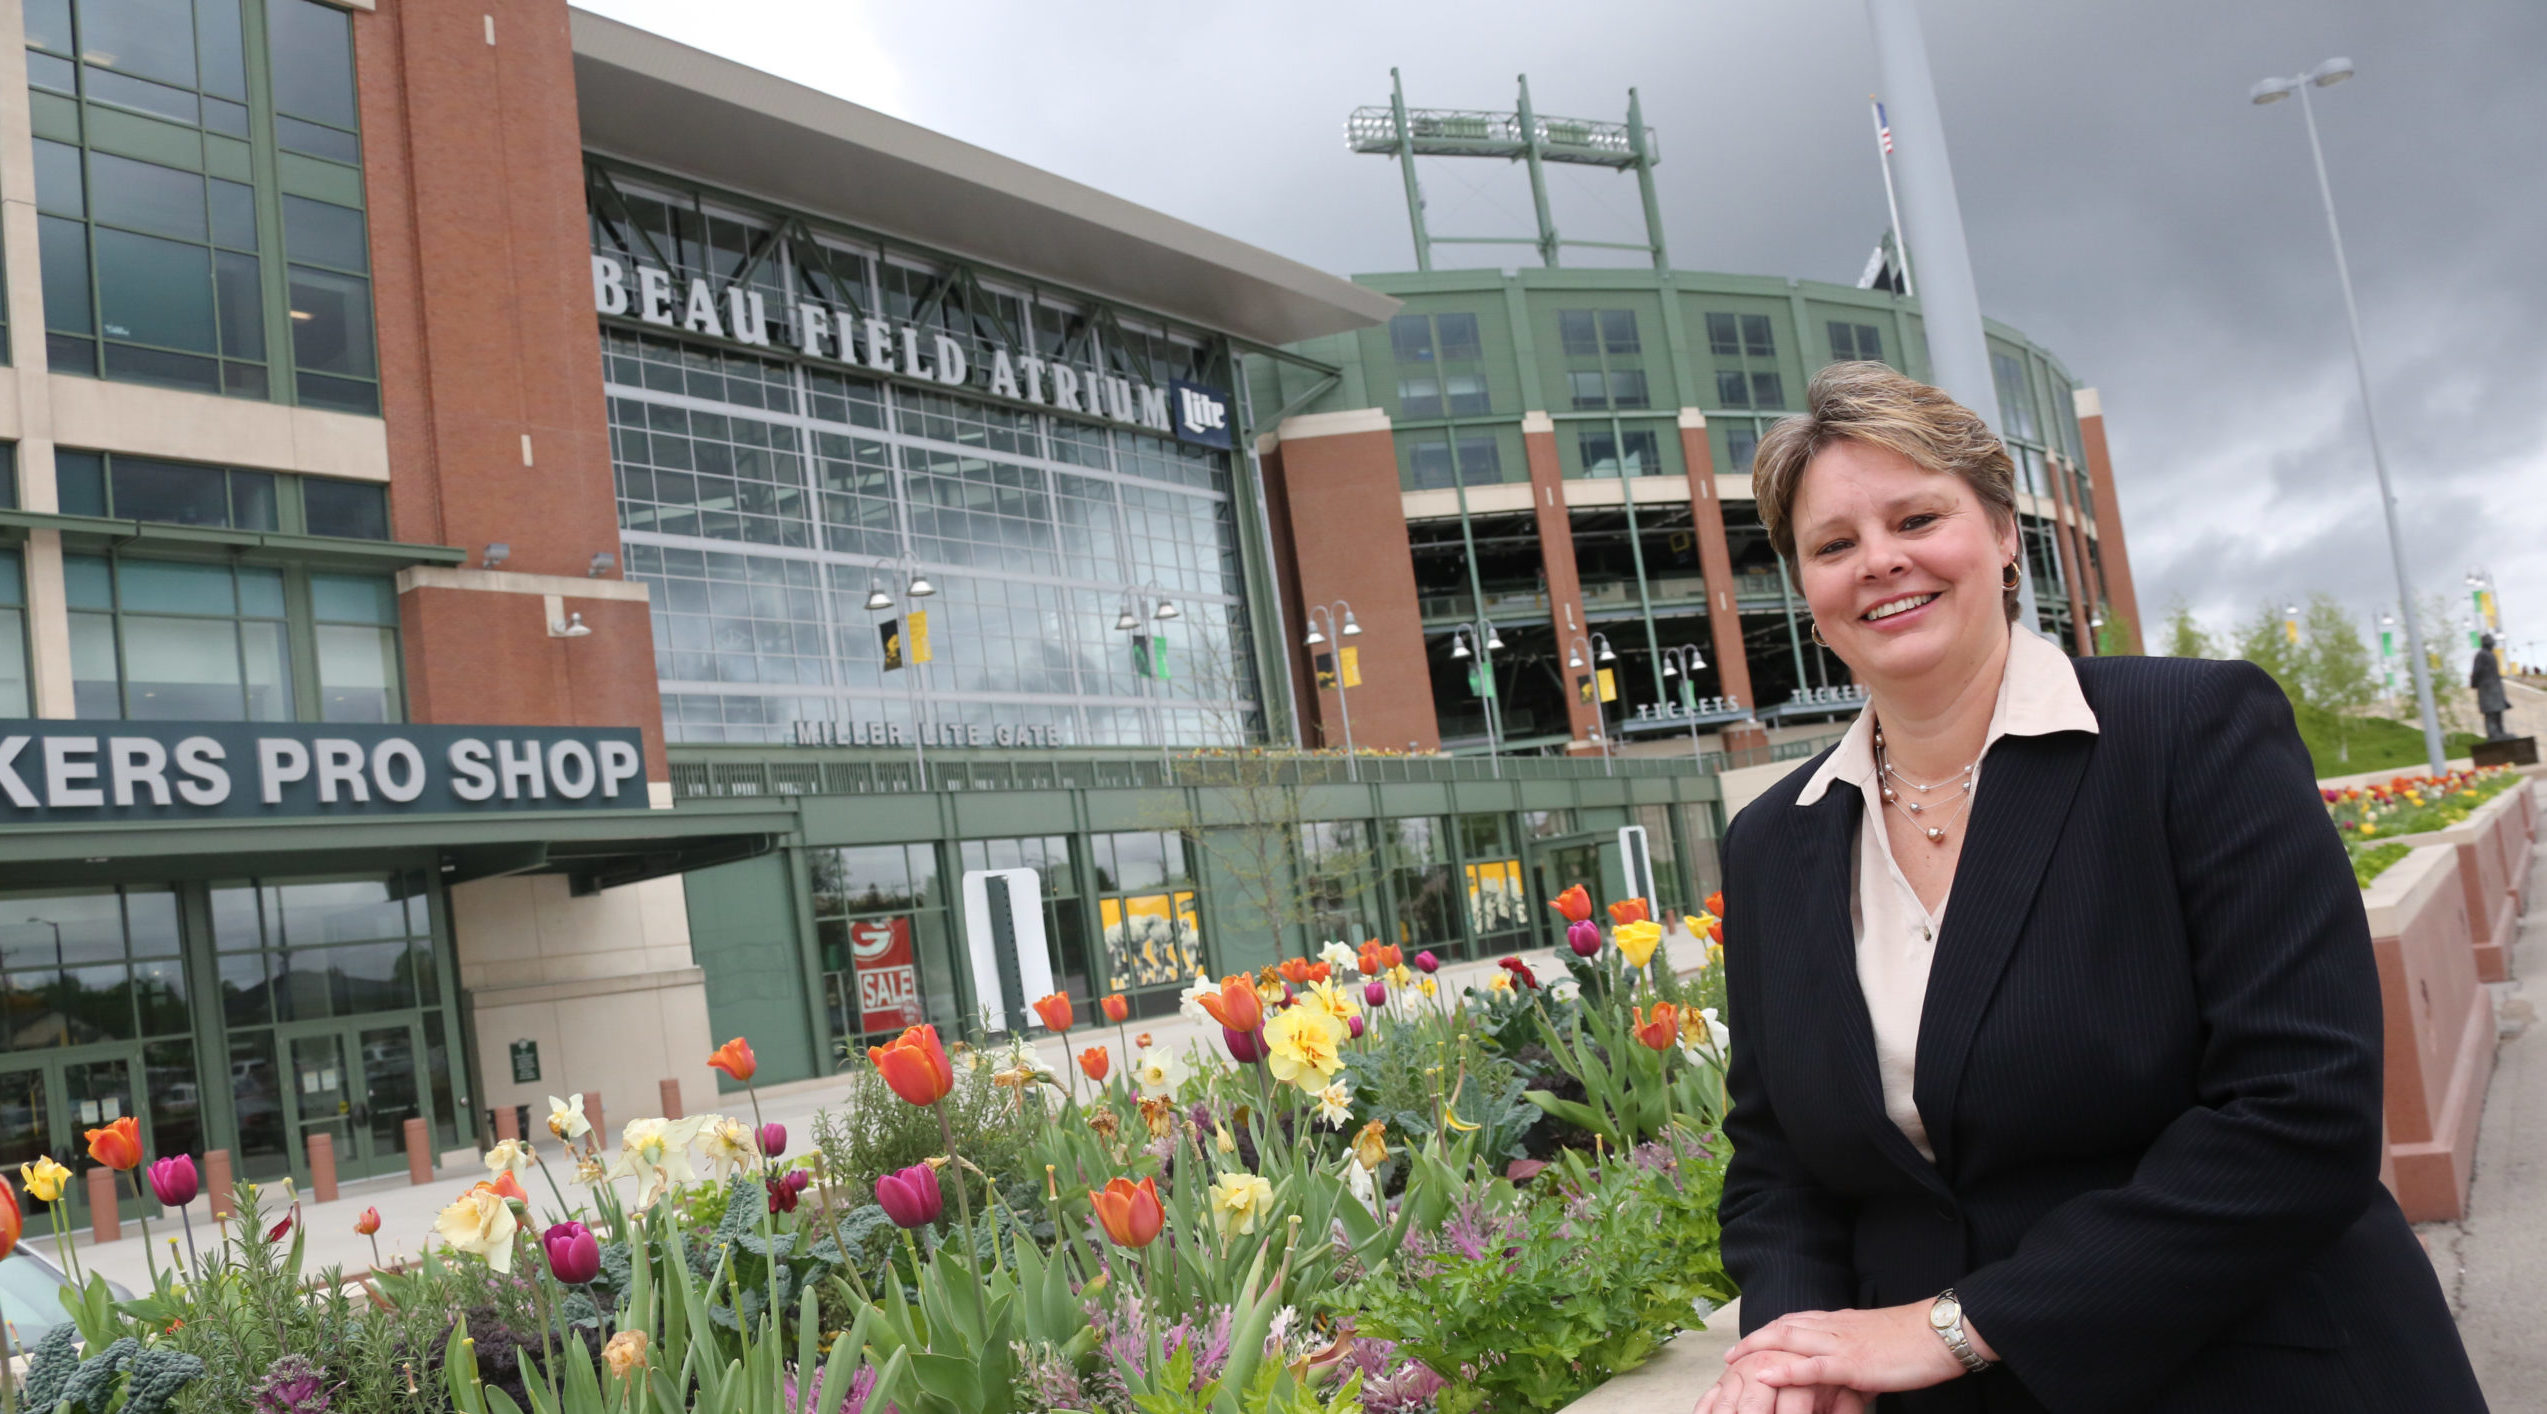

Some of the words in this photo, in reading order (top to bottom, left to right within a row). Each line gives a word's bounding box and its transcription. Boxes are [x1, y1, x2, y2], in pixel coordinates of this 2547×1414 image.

[591, 255, 770, 346] BEAU
[799, 302, 967, 386] FIELD
[989, 348, 1171, 432] ATRIUM
[1179, 387, 1225, 433] Lite
[1791, 684, 1870, 705] TICKET
[795, 720, 902, 746] MILLER
[919, 722, 980, 746] LITE
[995, 723, 1061, 747] GATE
[0, 736, 232, 807] KERS
[257, 737, 427, 803] PRO
[449, 738, 640, 800] SHOP
[863, 970, 913, 1008] SALE
